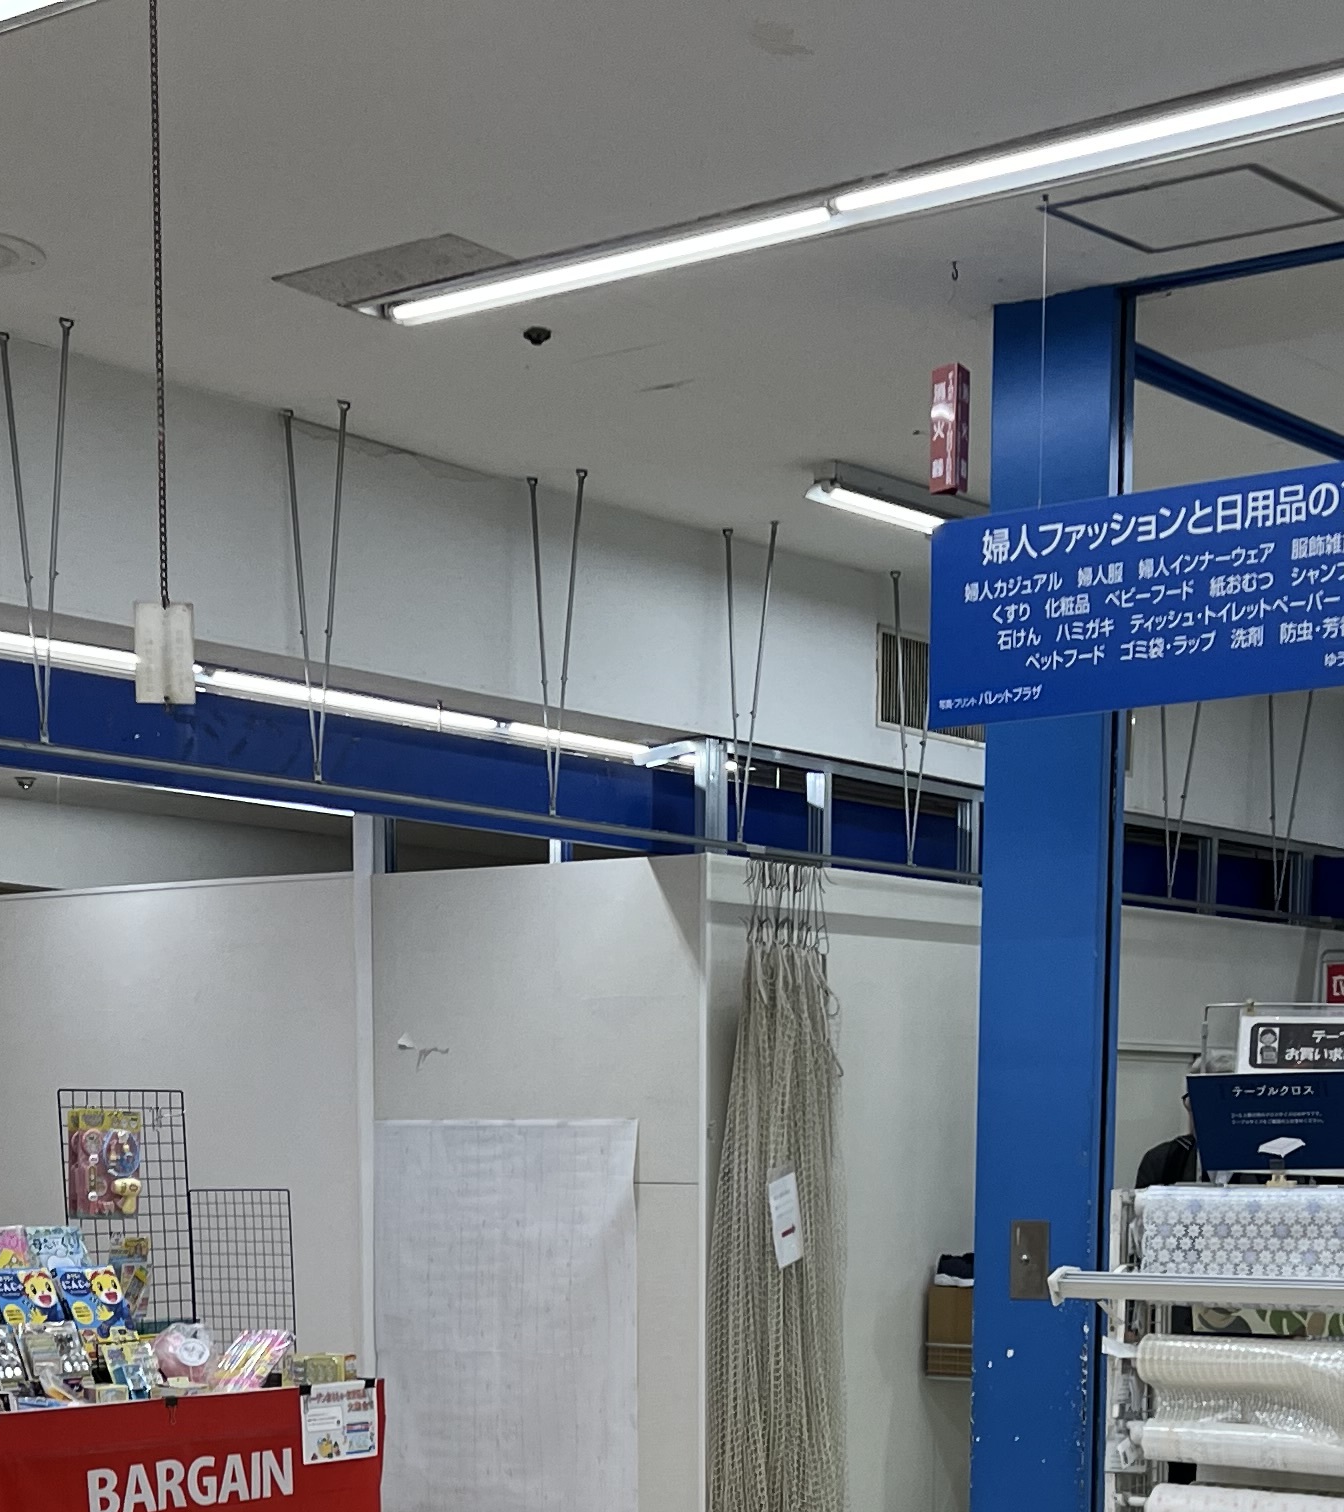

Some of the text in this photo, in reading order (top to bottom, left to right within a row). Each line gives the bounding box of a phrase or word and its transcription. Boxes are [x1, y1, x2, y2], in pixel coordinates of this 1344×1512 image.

[964, 571, 1062, 603] 婦人カジュアル
[1077, 562, 1123, 588] 婦人服
[1138, 543, 1275, 580] 婦人インナーウェア
[992, 604, 1031, 624] くすり
[1044, 593, 1090, 619] 化粧品
[1105, 580, 1194, 608] ベビーフード
[1209, 572, 1274, 598] 紙おむつ
[997, 627, 1042, 650] 石けん
[1056, 618, 1115, 642] ハミガキ
[1025, 645, 1105, 671] ペットフード
[1120, 630, 1216, 661] ゴミ袋・ラップ
[1231, 625, 1264, 649] 洗剤
[1232, 1084, 1315, 1097] テーブルクロス
